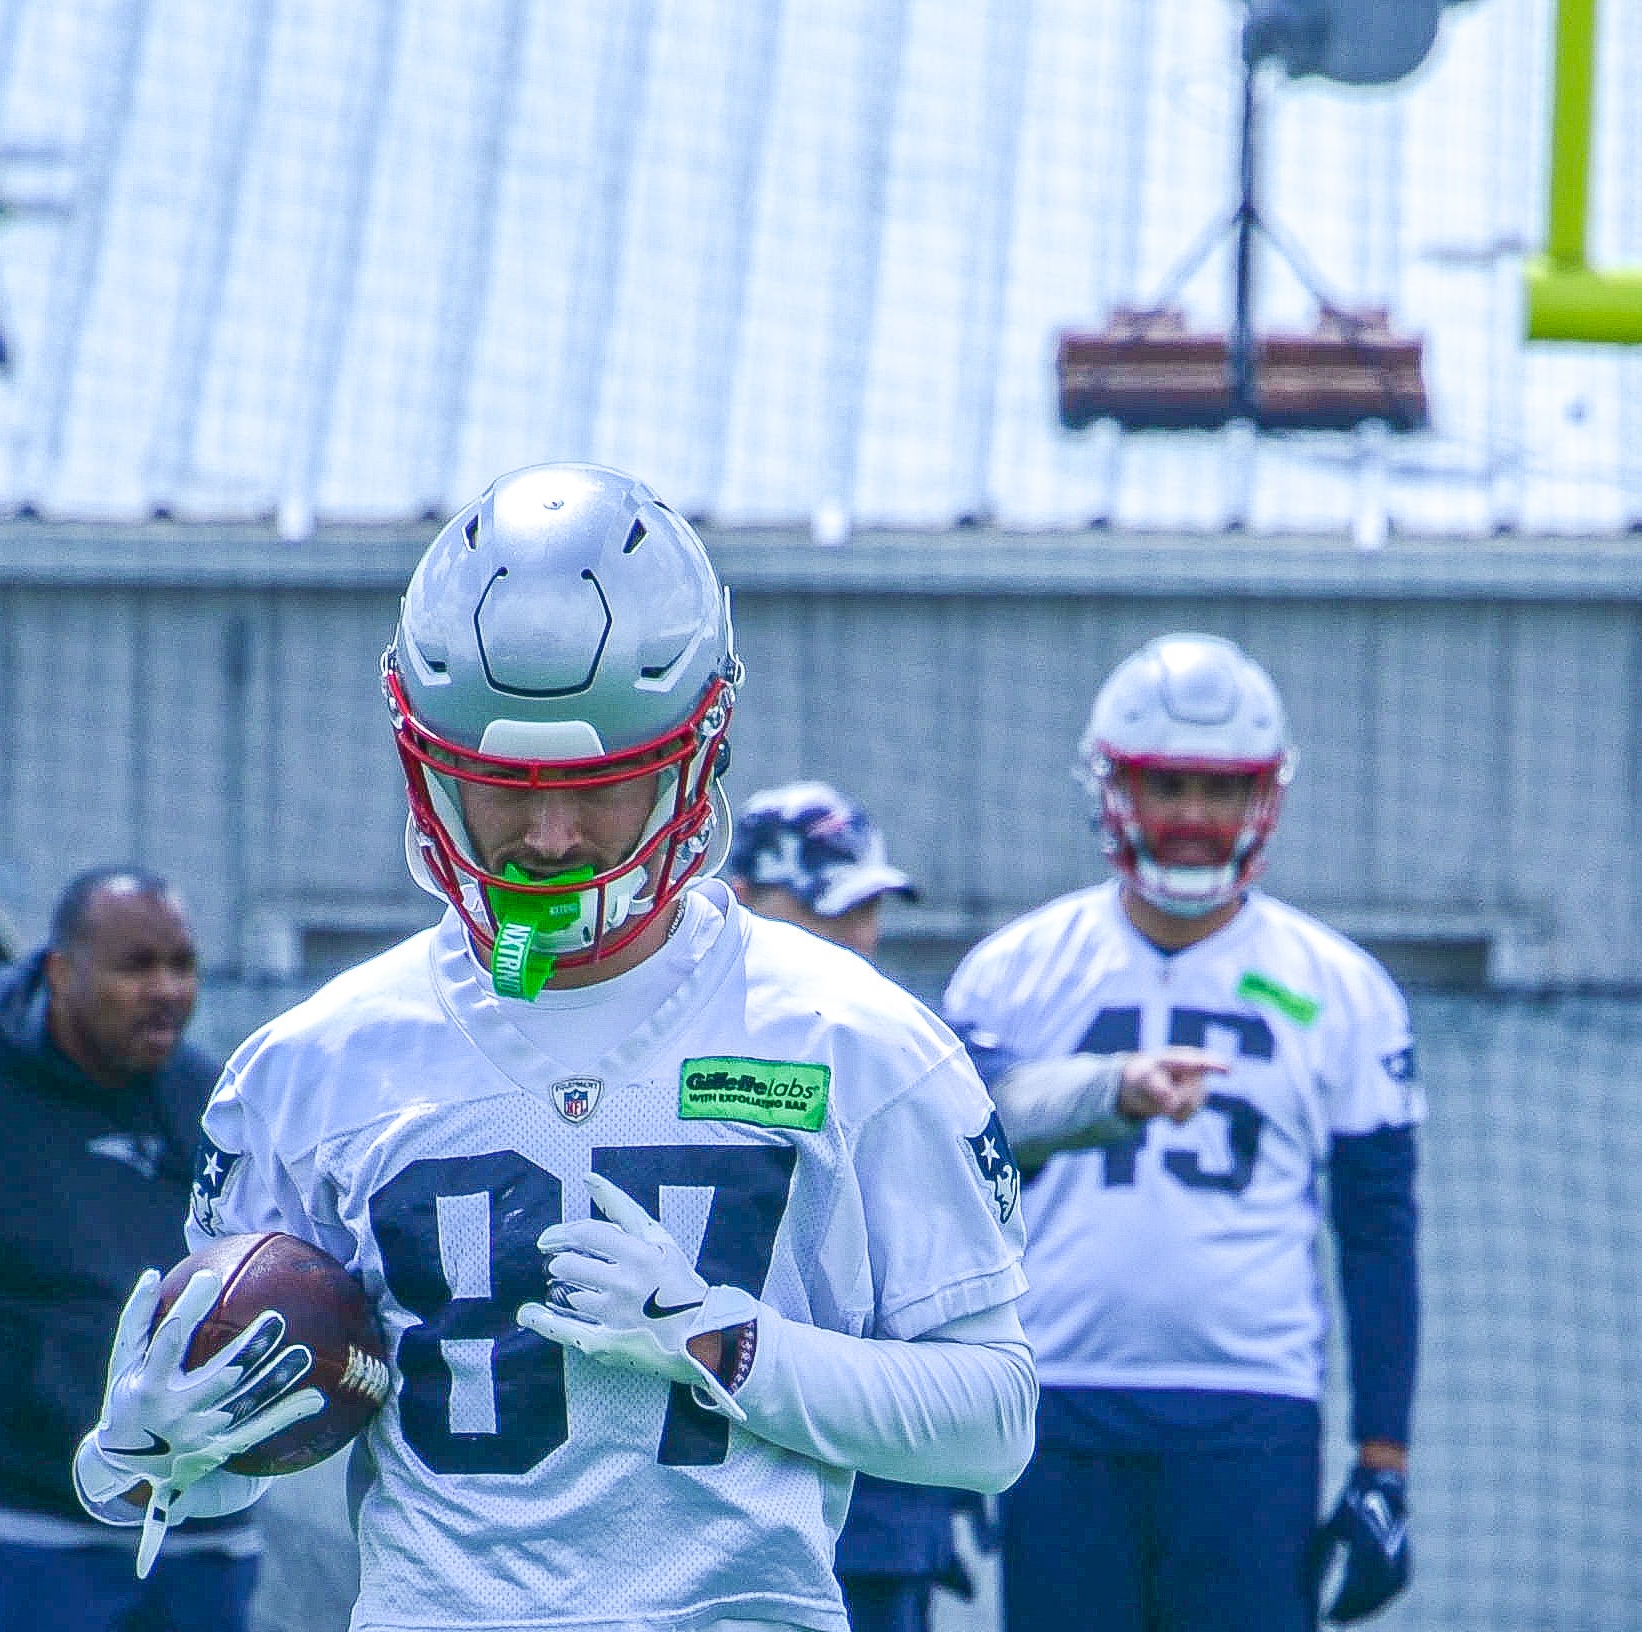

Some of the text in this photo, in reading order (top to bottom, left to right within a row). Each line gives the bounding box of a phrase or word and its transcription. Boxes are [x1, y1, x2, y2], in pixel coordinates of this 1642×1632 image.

[689, 1093, 717, 1104] WITH
[784, 1100, 808, 1112] BAR
[367, 1144, 797, 1476] 87
